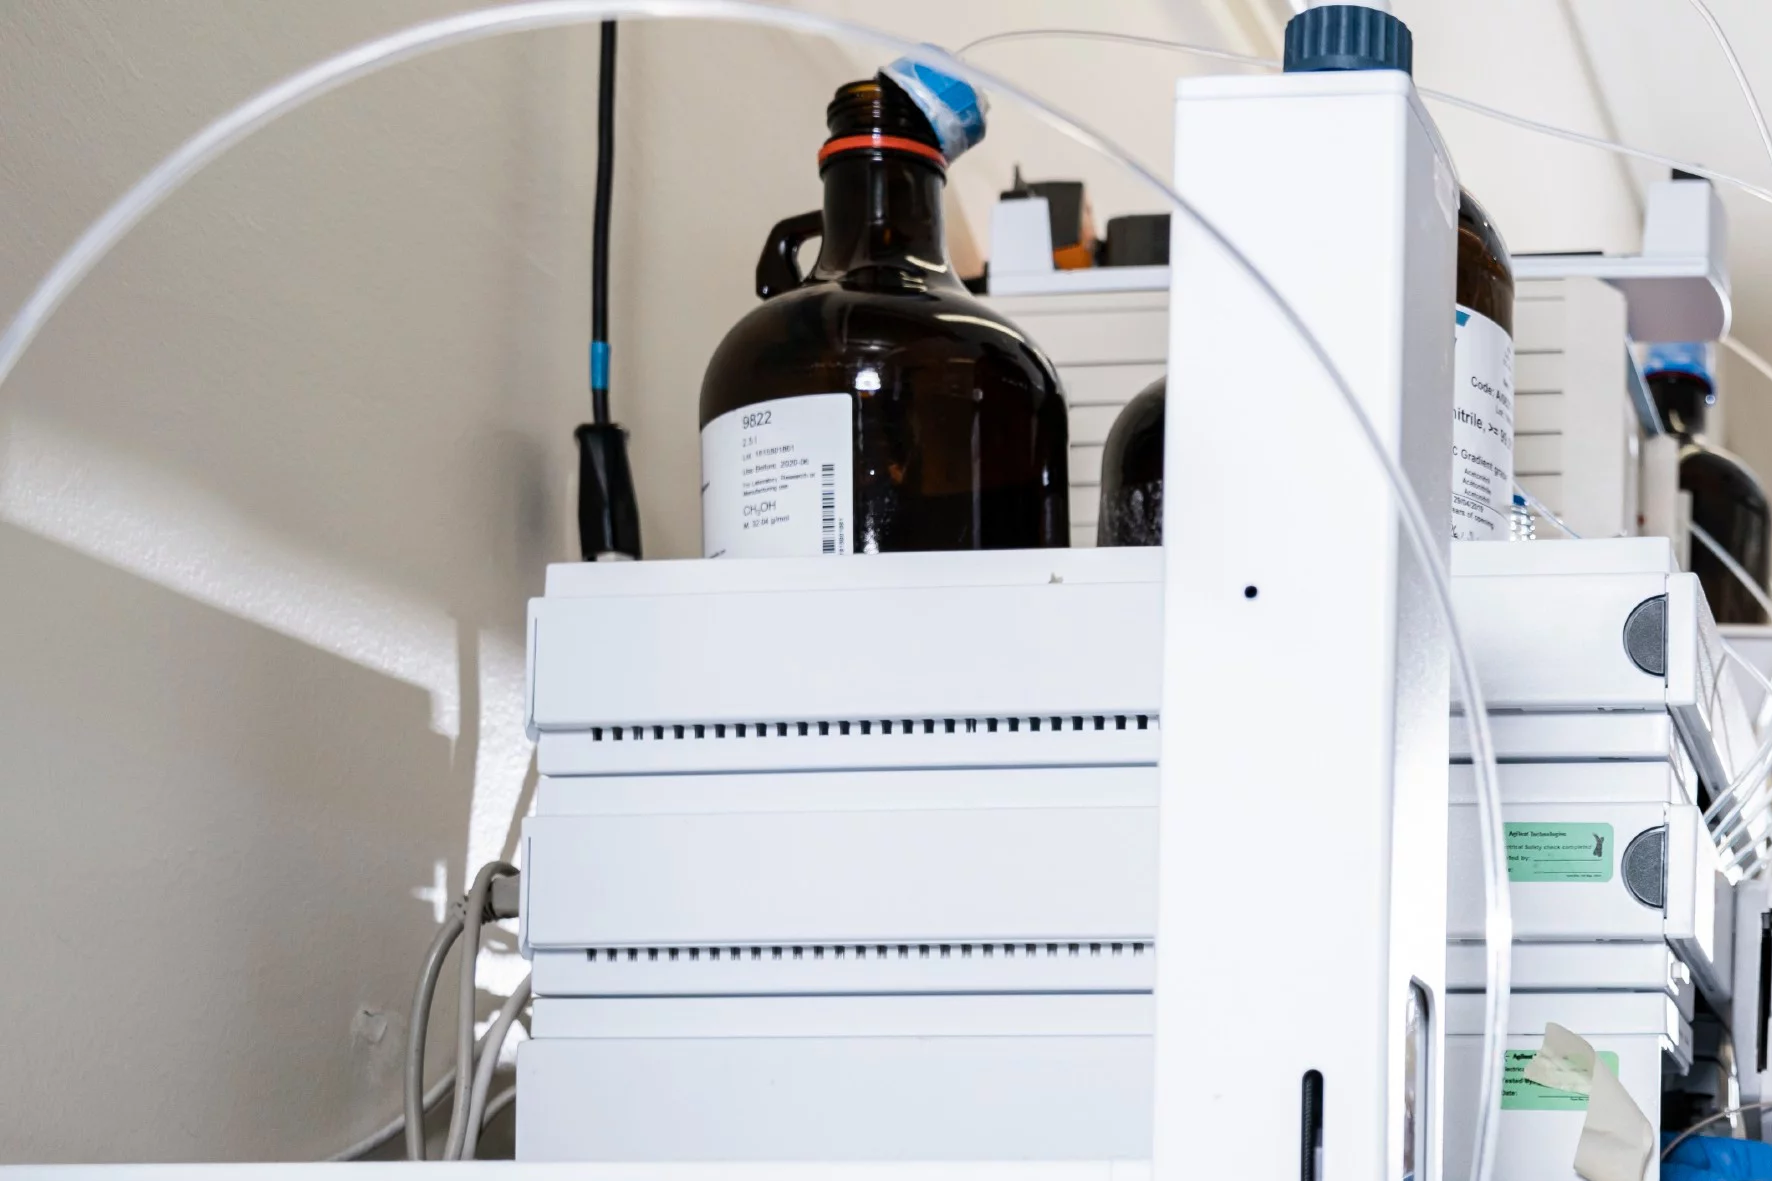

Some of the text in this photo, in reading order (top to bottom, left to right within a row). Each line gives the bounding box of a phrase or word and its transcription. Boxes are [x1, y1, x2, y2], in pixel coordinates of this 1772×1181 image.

[742, 410, 772, 429] 9822
[1460, 448, 1493, 471] Gradient
[1530, 831, 1568, 839] Technologies
[1524, 844, 1543, 852] Safety
